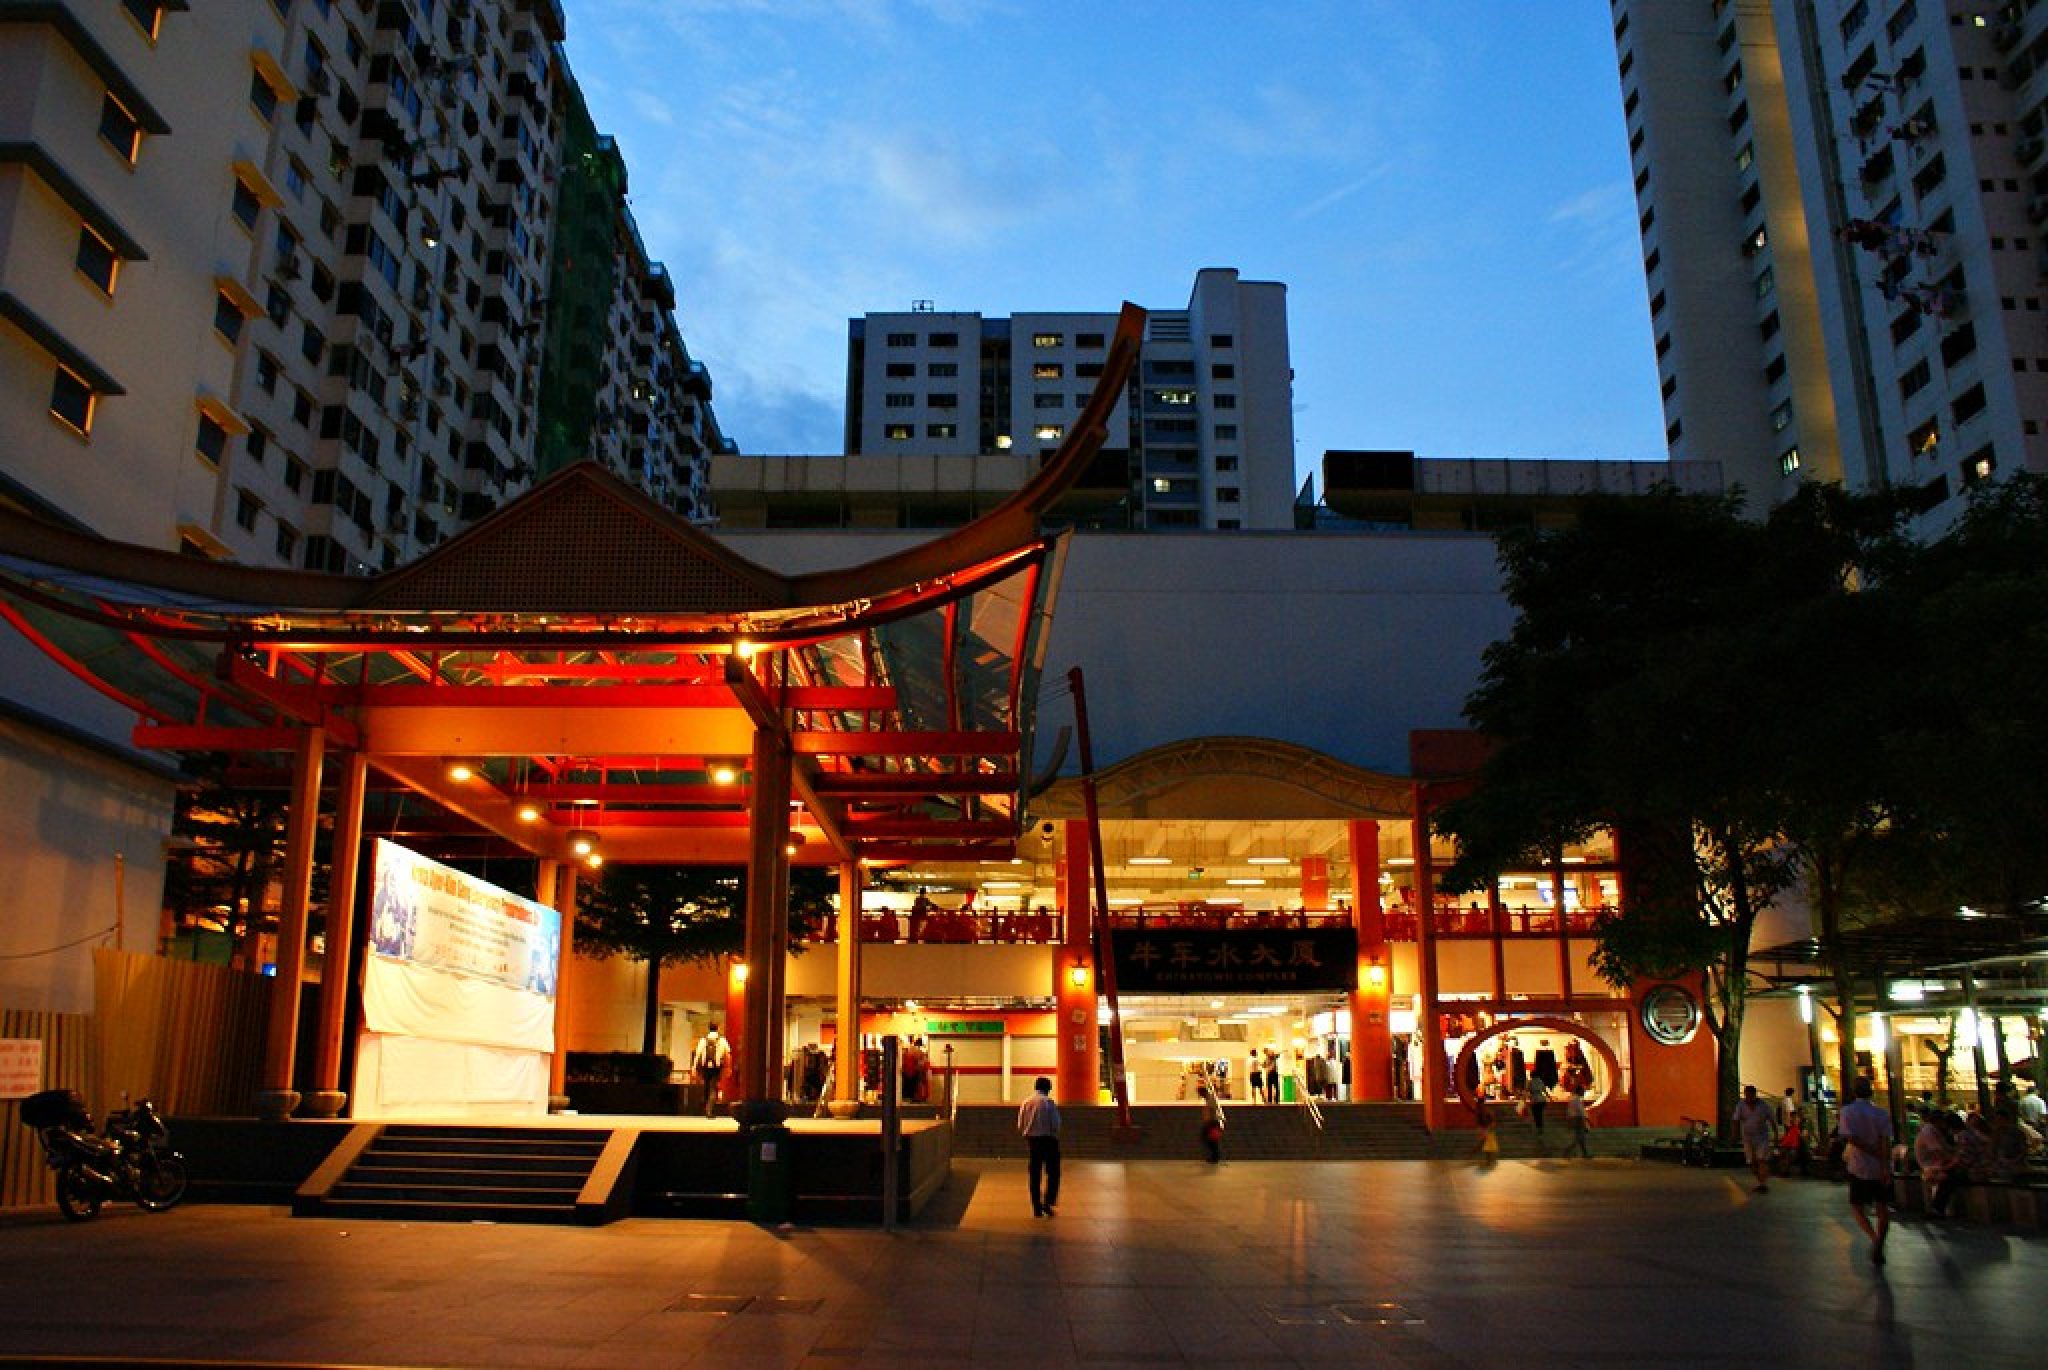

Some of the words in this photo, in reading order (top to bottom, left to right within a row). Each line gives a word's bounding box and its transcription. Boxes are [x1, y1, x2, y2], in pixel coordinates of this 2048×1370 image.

[1129, 938, 1322, 970] 牛车水大厦
